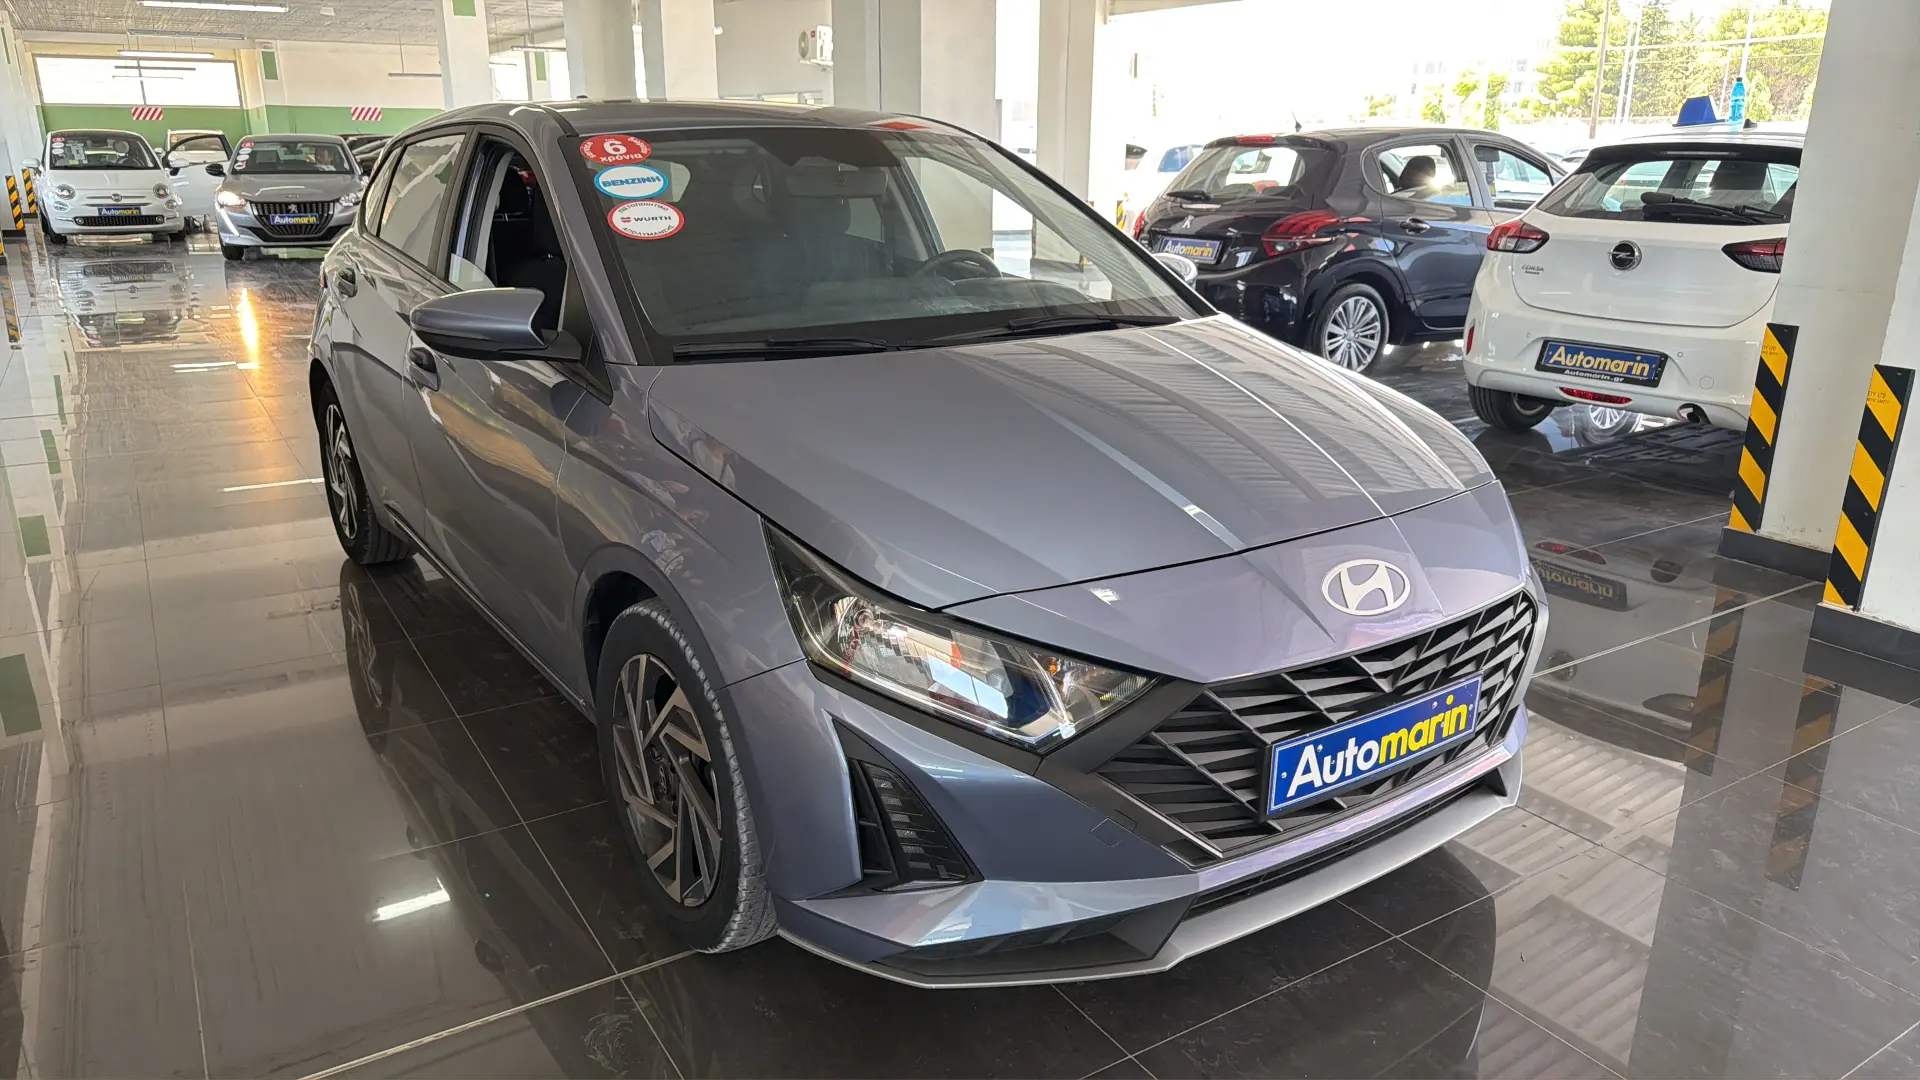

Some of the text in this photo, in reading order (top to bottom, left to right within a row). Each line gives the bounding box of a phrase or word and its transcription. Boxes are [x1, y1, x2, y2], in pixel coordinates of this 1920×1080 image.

[603, 140, 627, 155] 6
[600, 153, 643, 163] χρόνια
[101, 207, 140, 215] Automarin
[274, 214, 317, 224] Automarin
[1163, 240, 1213, 257] Automarin
[1548, 345, 1650, 377] Automarin
[1564, 369, 1624, 382] Automarin.gr
[1286, 694, 1468, 798] Automarin
